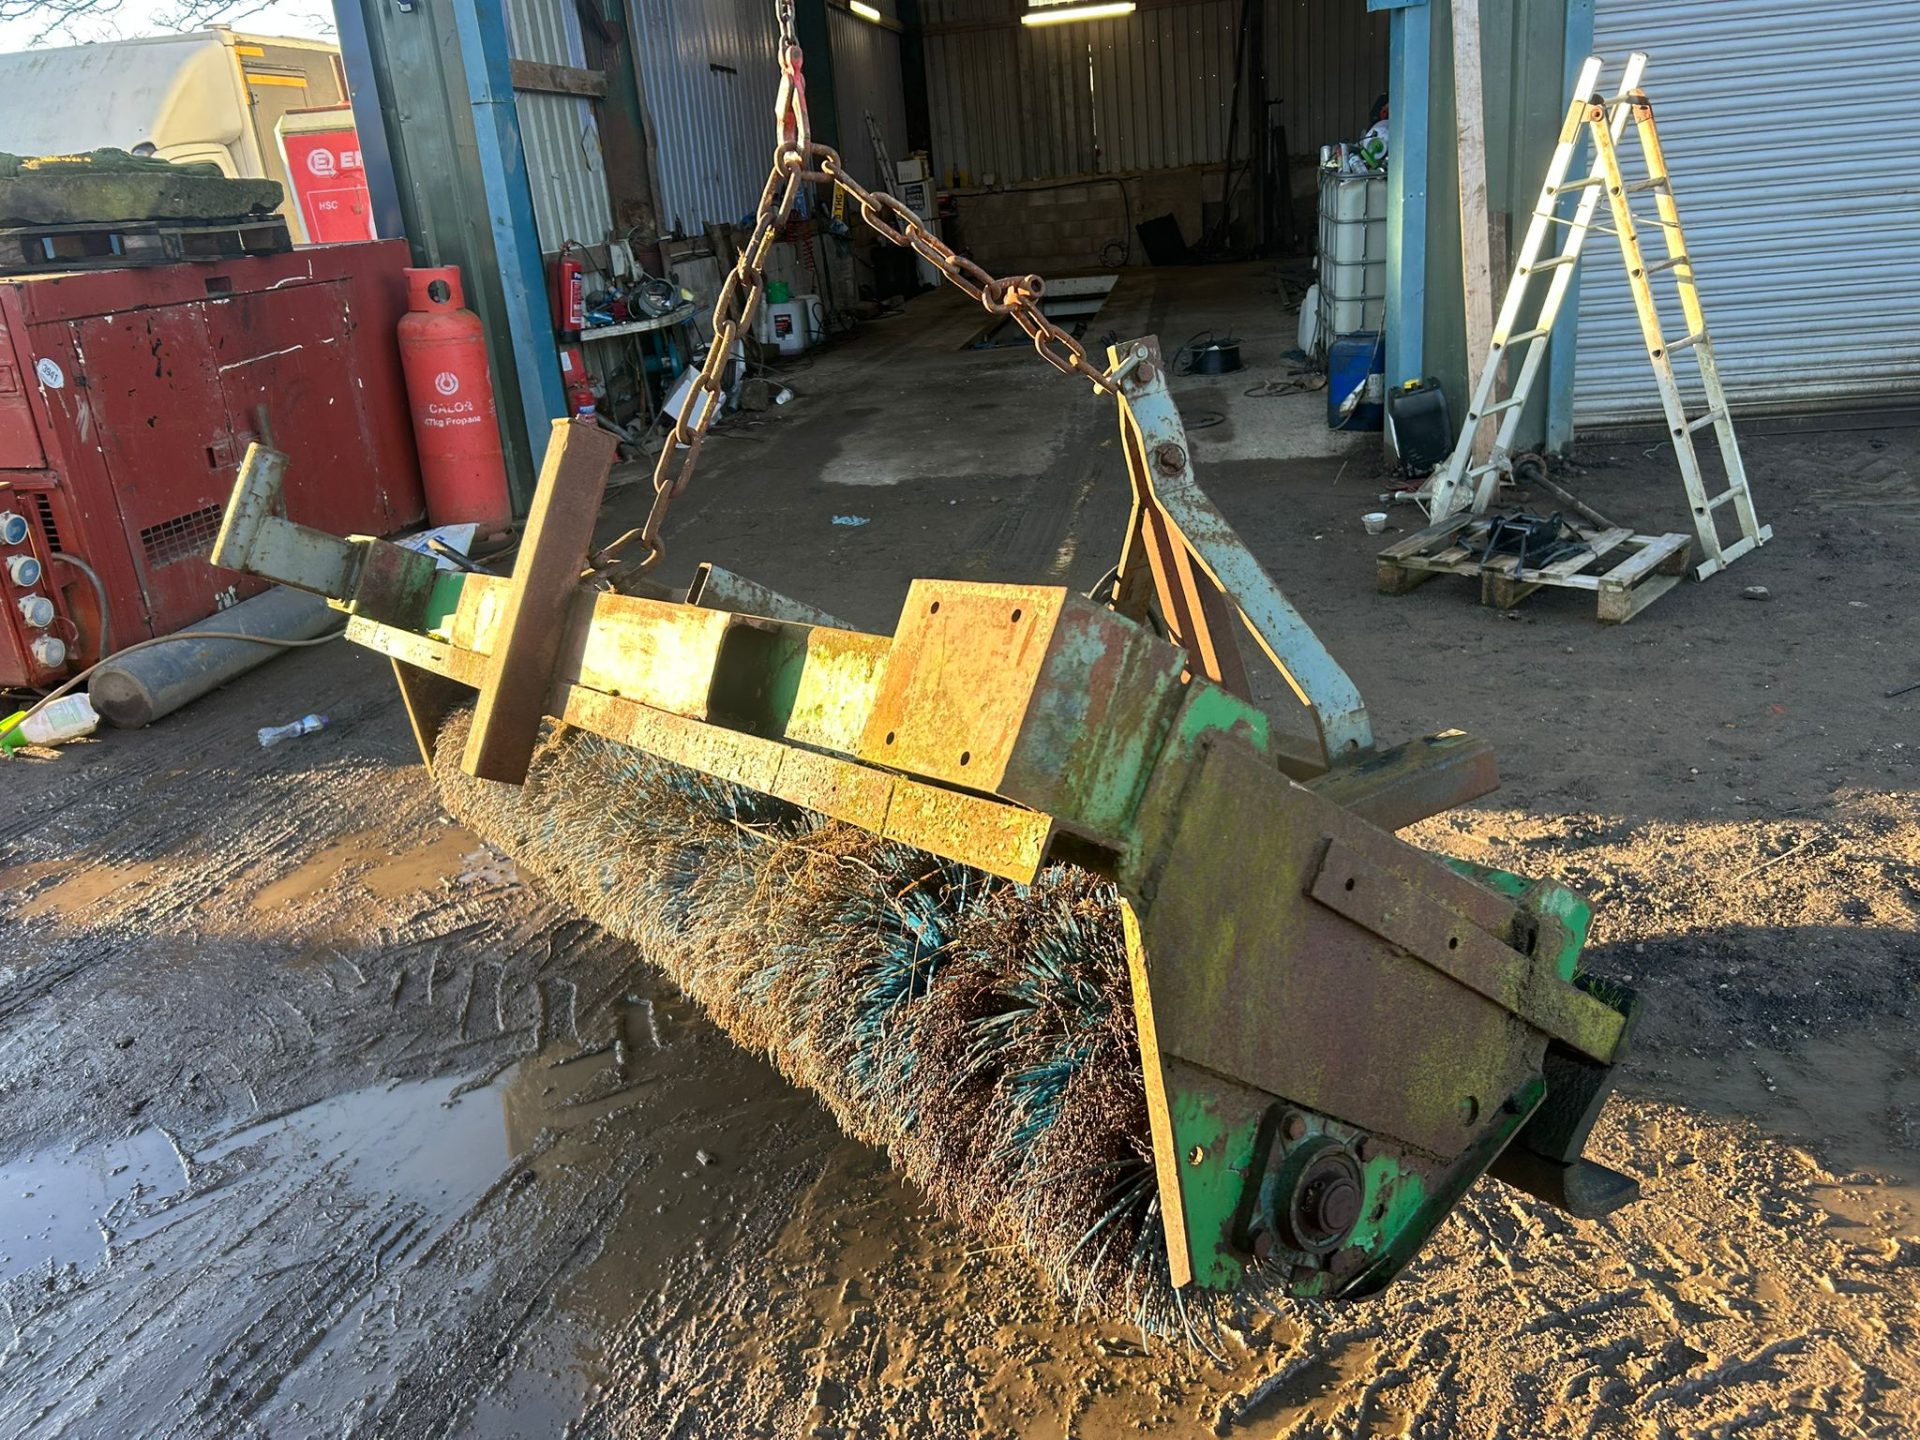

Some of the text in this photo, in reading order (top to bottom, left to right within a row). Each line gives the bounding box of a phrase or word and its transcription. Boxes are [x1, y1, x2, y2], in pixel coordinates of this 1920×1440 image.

[319, 200, 338, 210] HSC
[428, 401, 473, 414] CALOR
[445, 415, 481, 426] Propane
